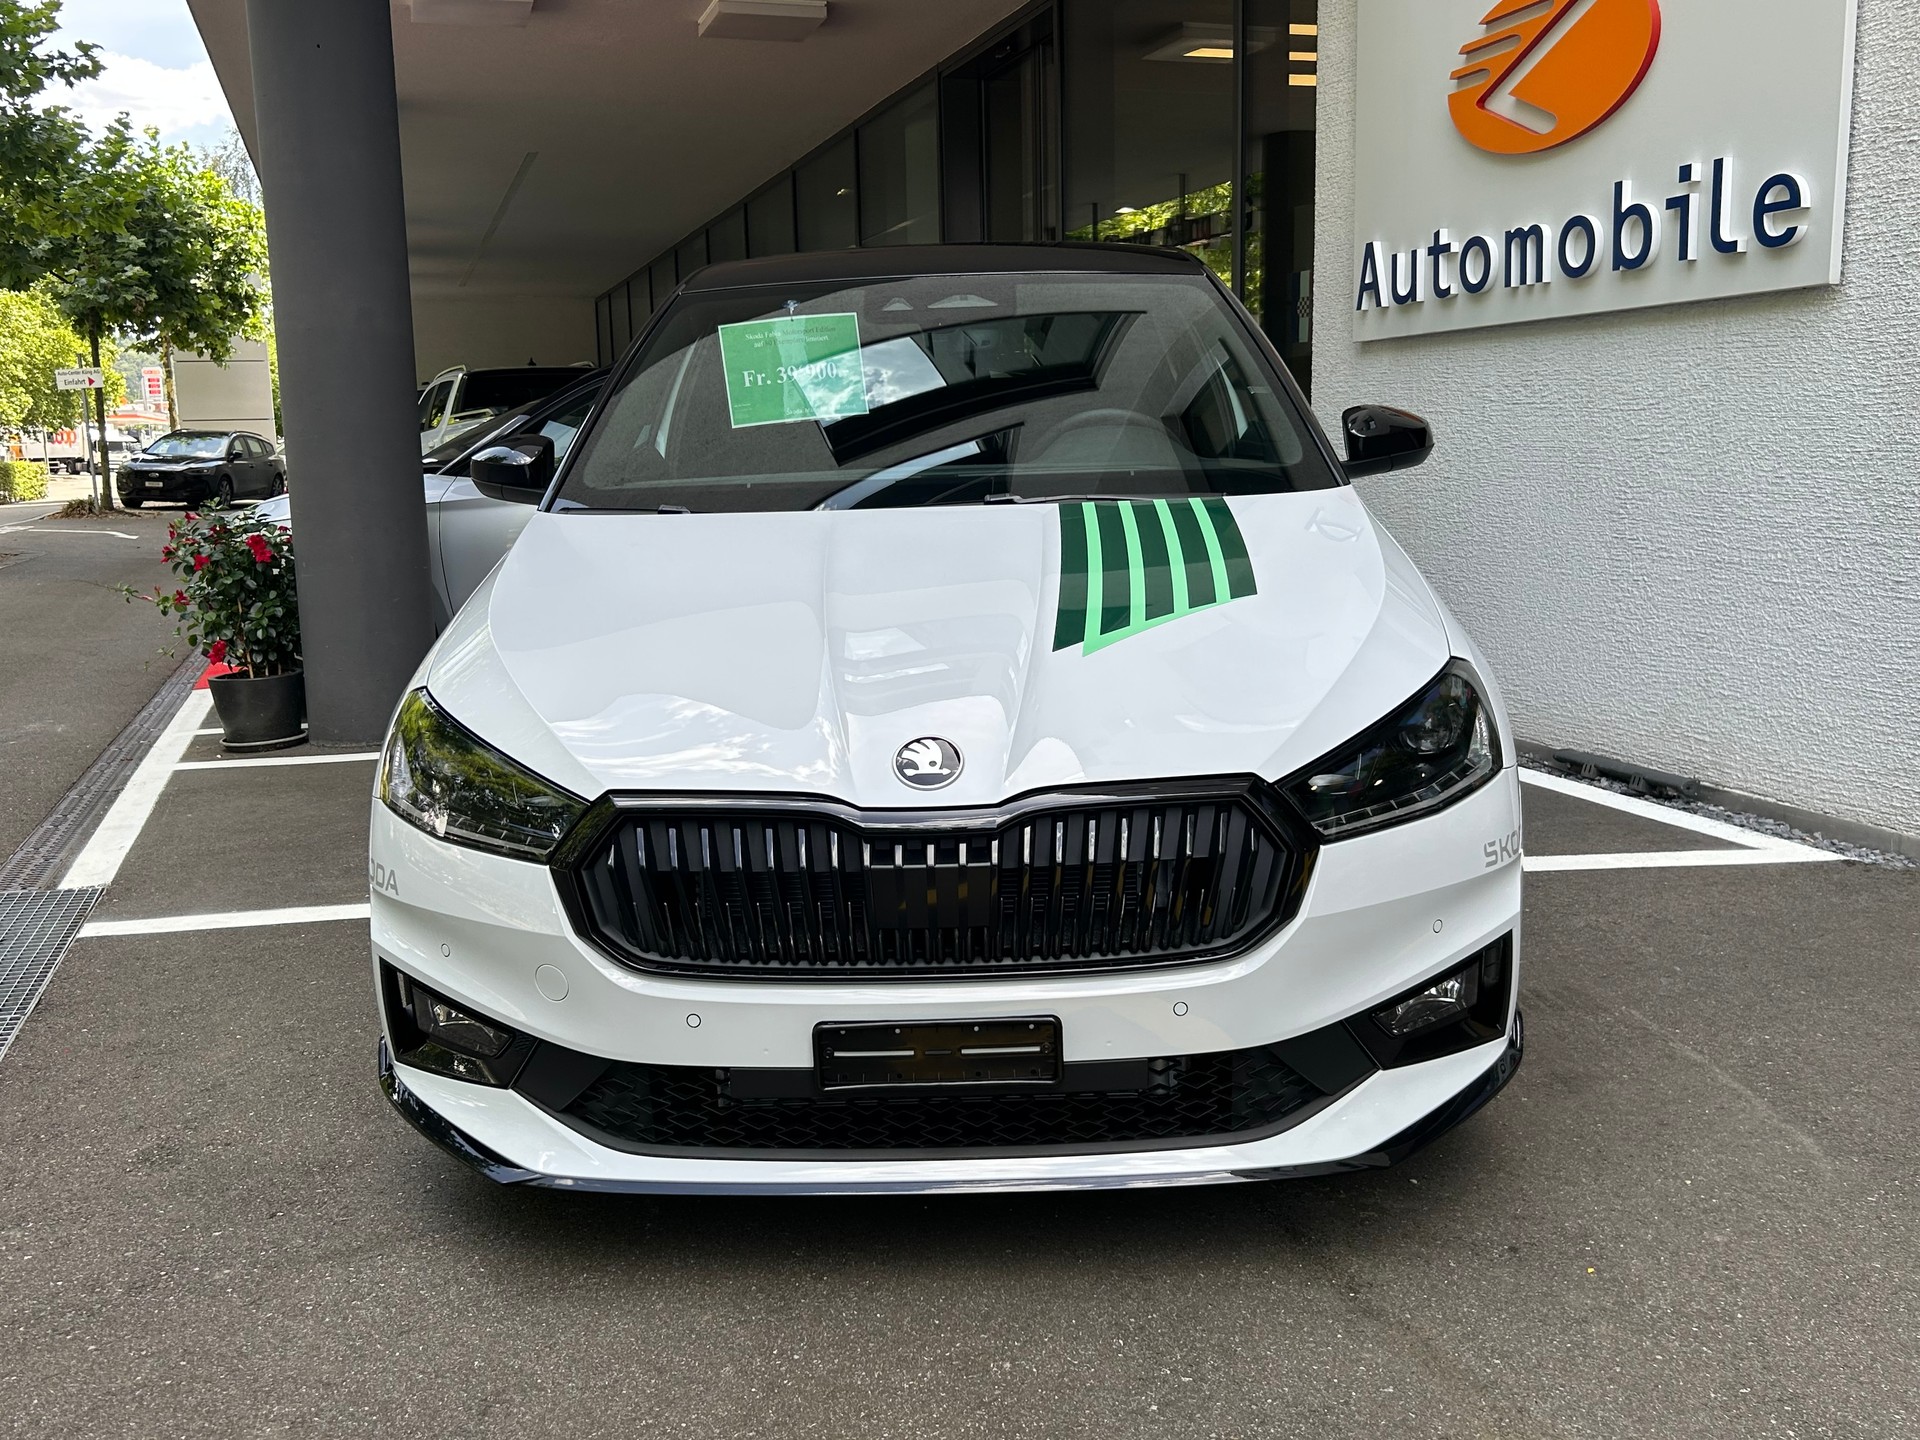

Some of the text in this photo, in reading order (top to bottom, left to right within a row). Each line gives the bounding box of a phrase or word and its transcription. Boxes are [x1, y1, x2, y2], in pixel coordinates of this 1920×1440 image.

[1356, 156, 1812, 311] Automobile
[63, 378, 87, 386] Einfahrt
[742, 369, 772, 388] Fr.
[1483, 824, 1521, 868] SKO
